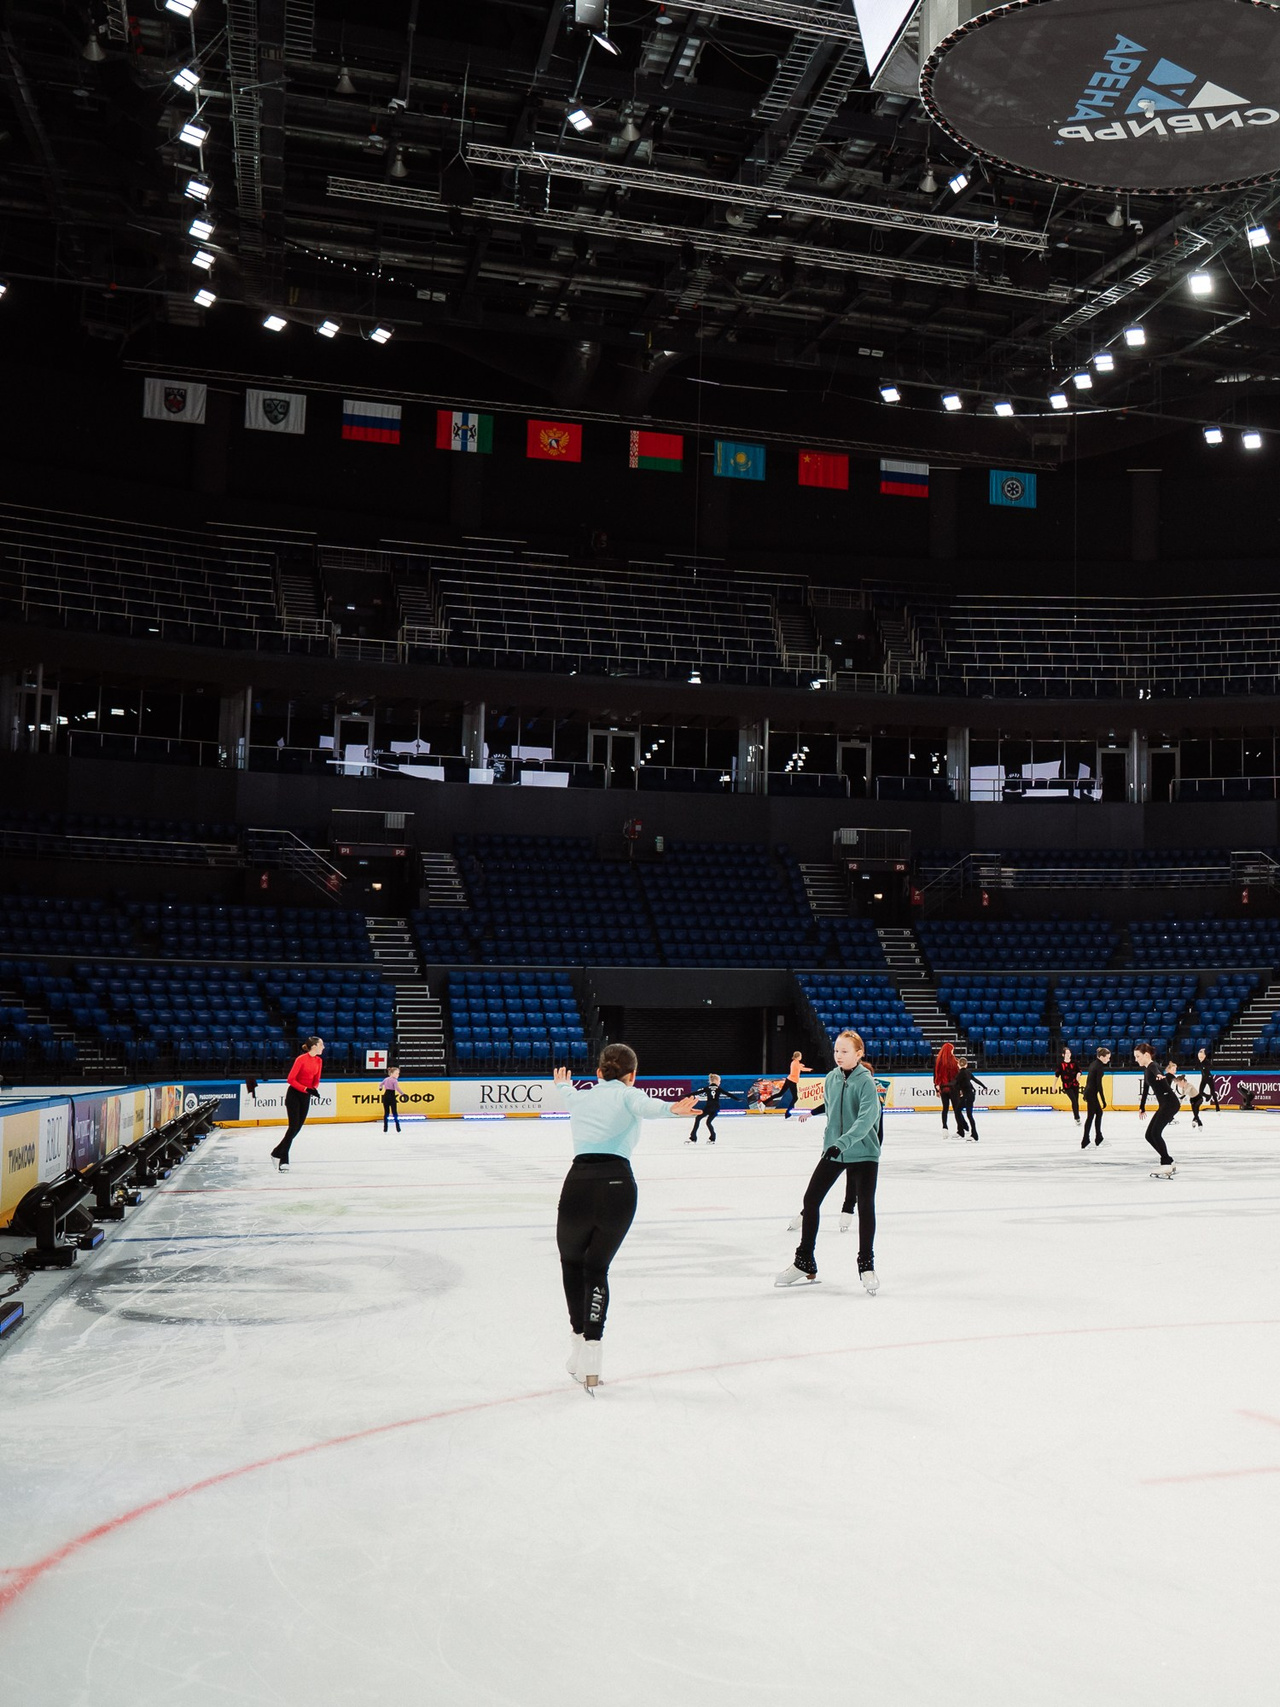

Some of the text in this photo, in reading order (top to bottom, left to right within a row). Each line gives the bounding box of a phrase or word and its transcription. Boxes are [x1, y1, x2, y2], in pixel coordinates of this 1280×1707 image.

[1066, 33, 1148, 122] АРЕНА
[1057, 107, 1280, 143] СИБИРЬ
[352, 1093, 435, 1104] ТИНКОФФ
[479, 1084, 543, 1104] RRCC
